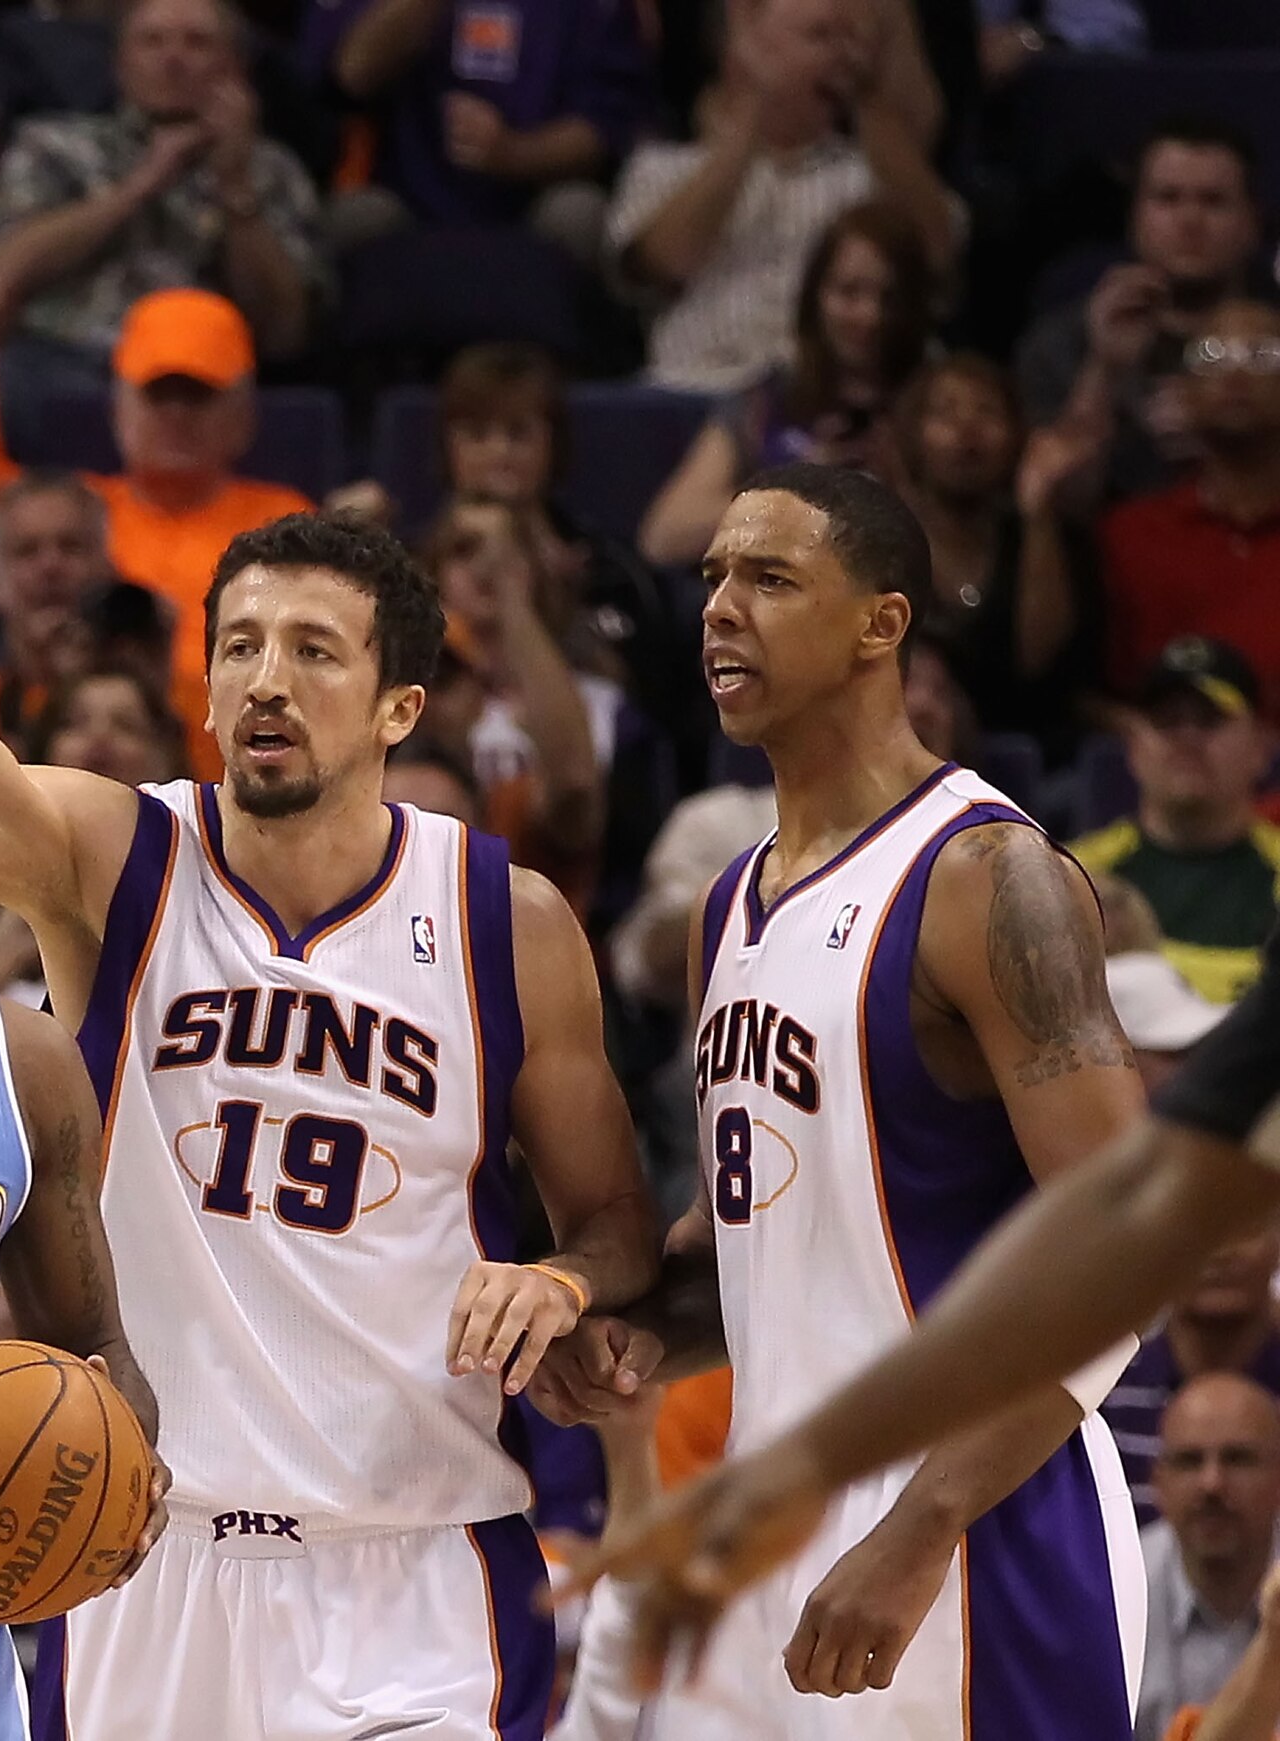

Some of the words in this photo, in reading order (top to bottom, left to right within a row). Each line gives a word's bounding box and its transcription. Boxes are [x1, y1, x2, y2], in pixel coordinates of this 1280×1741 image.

[151, 986, 439, 1118] SUNS
[201, 1099, 368, 1235] 19
[715, 1106, 752, 1226] 8
[211, 1509, 303, 1543] PHX
